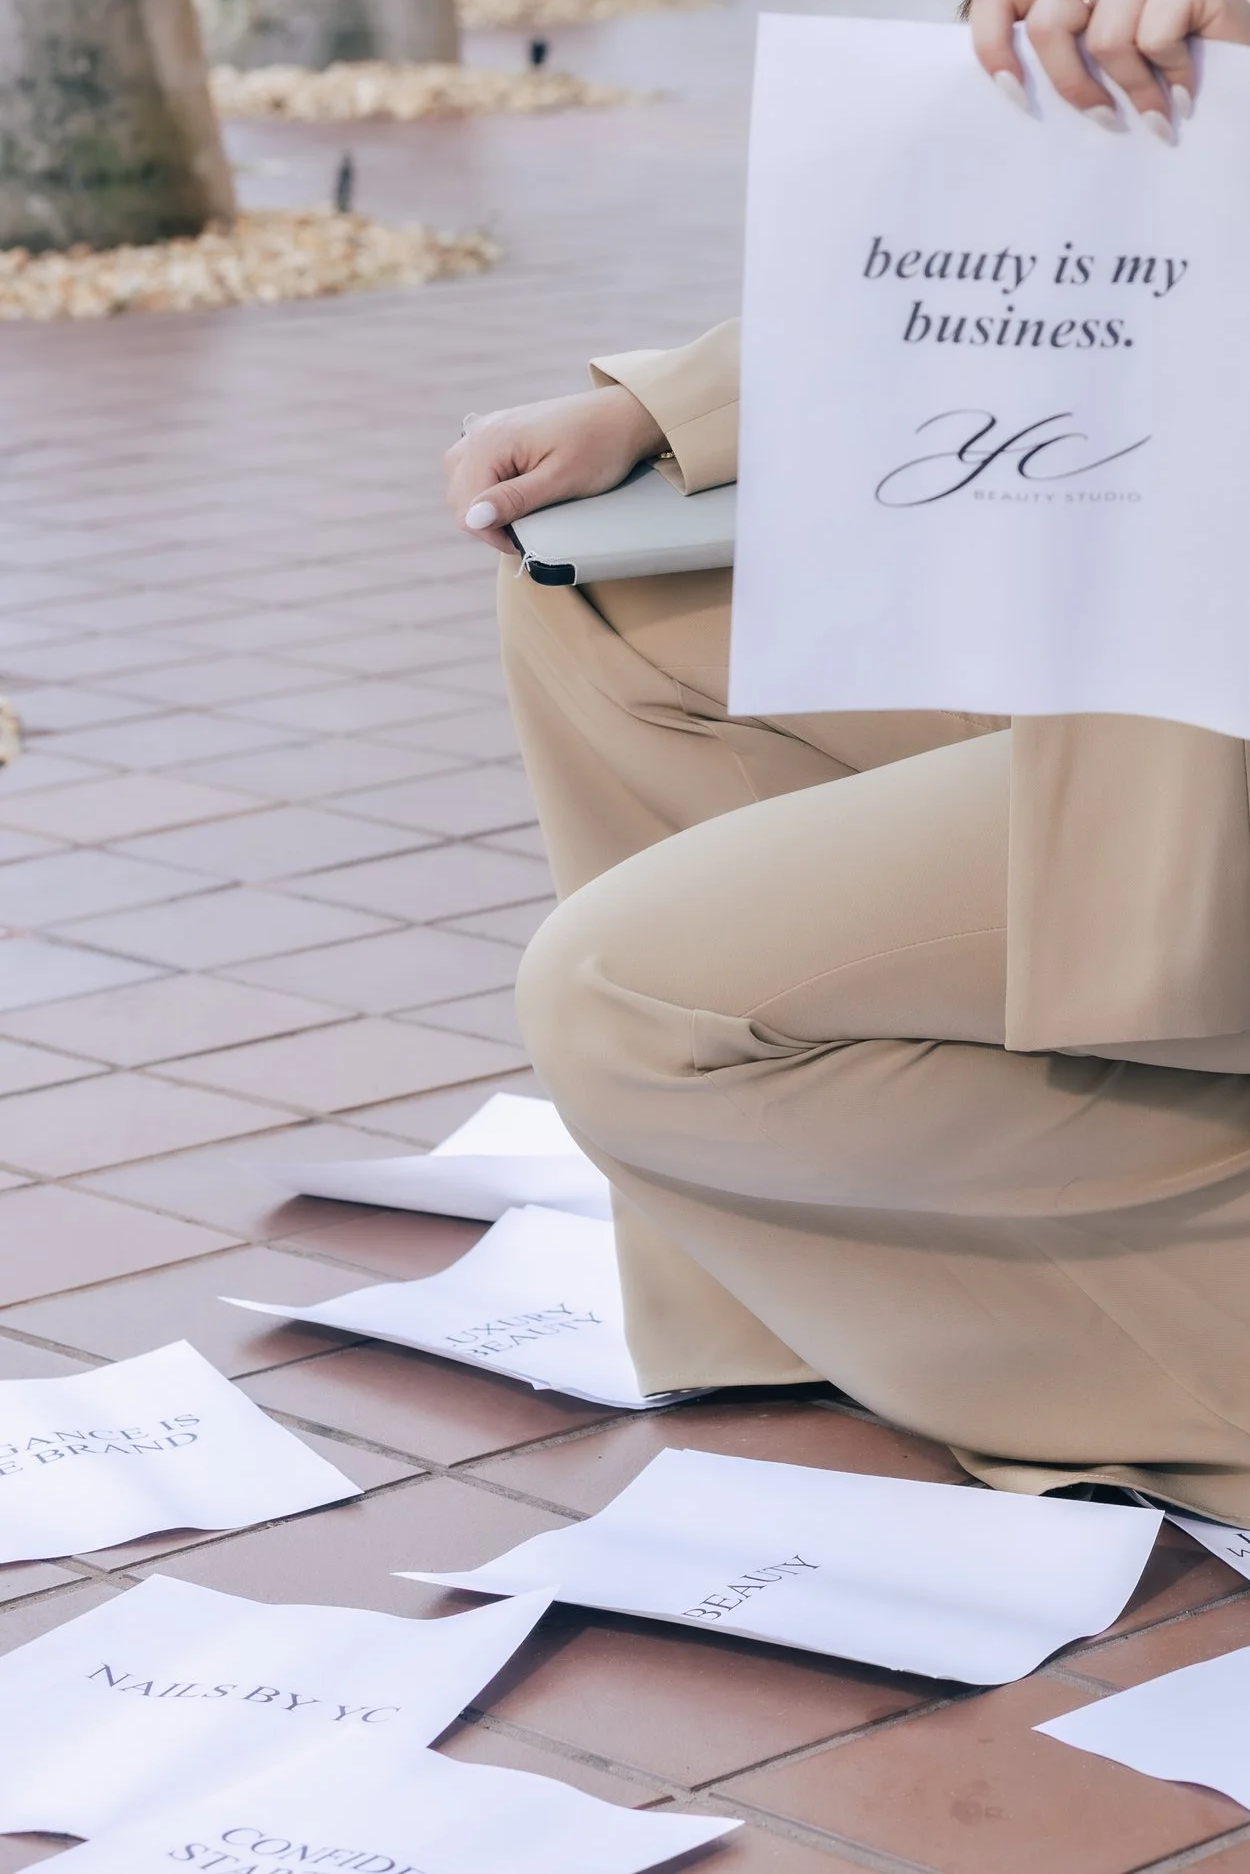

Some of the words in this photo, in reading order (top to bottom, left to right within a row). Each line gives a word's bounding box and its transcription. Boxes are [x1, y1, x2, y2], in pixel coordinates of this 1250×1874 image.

[863, 236, 1037, 295] beauty
[1054, 242, 1095, 285] is
[1111, 254, 1188, 297] my
[903, 300, 1134, 349] business.
[974, 489, 1056, 503] BEAUTY
[1065, 491, 1142, 503] STUDIO
[446, 1302, 573, 1348] UXURY
[159, 1413, 200, 1431] IS
[34, 1432, 198, 1464] BRAND
[681, 1554, 821, 1621] BEAUTY
[88, 1663, 238, 1698] NAILS
[243, 1685, 321, 1713] BY
[332, 1704, 401, 1724] YC
